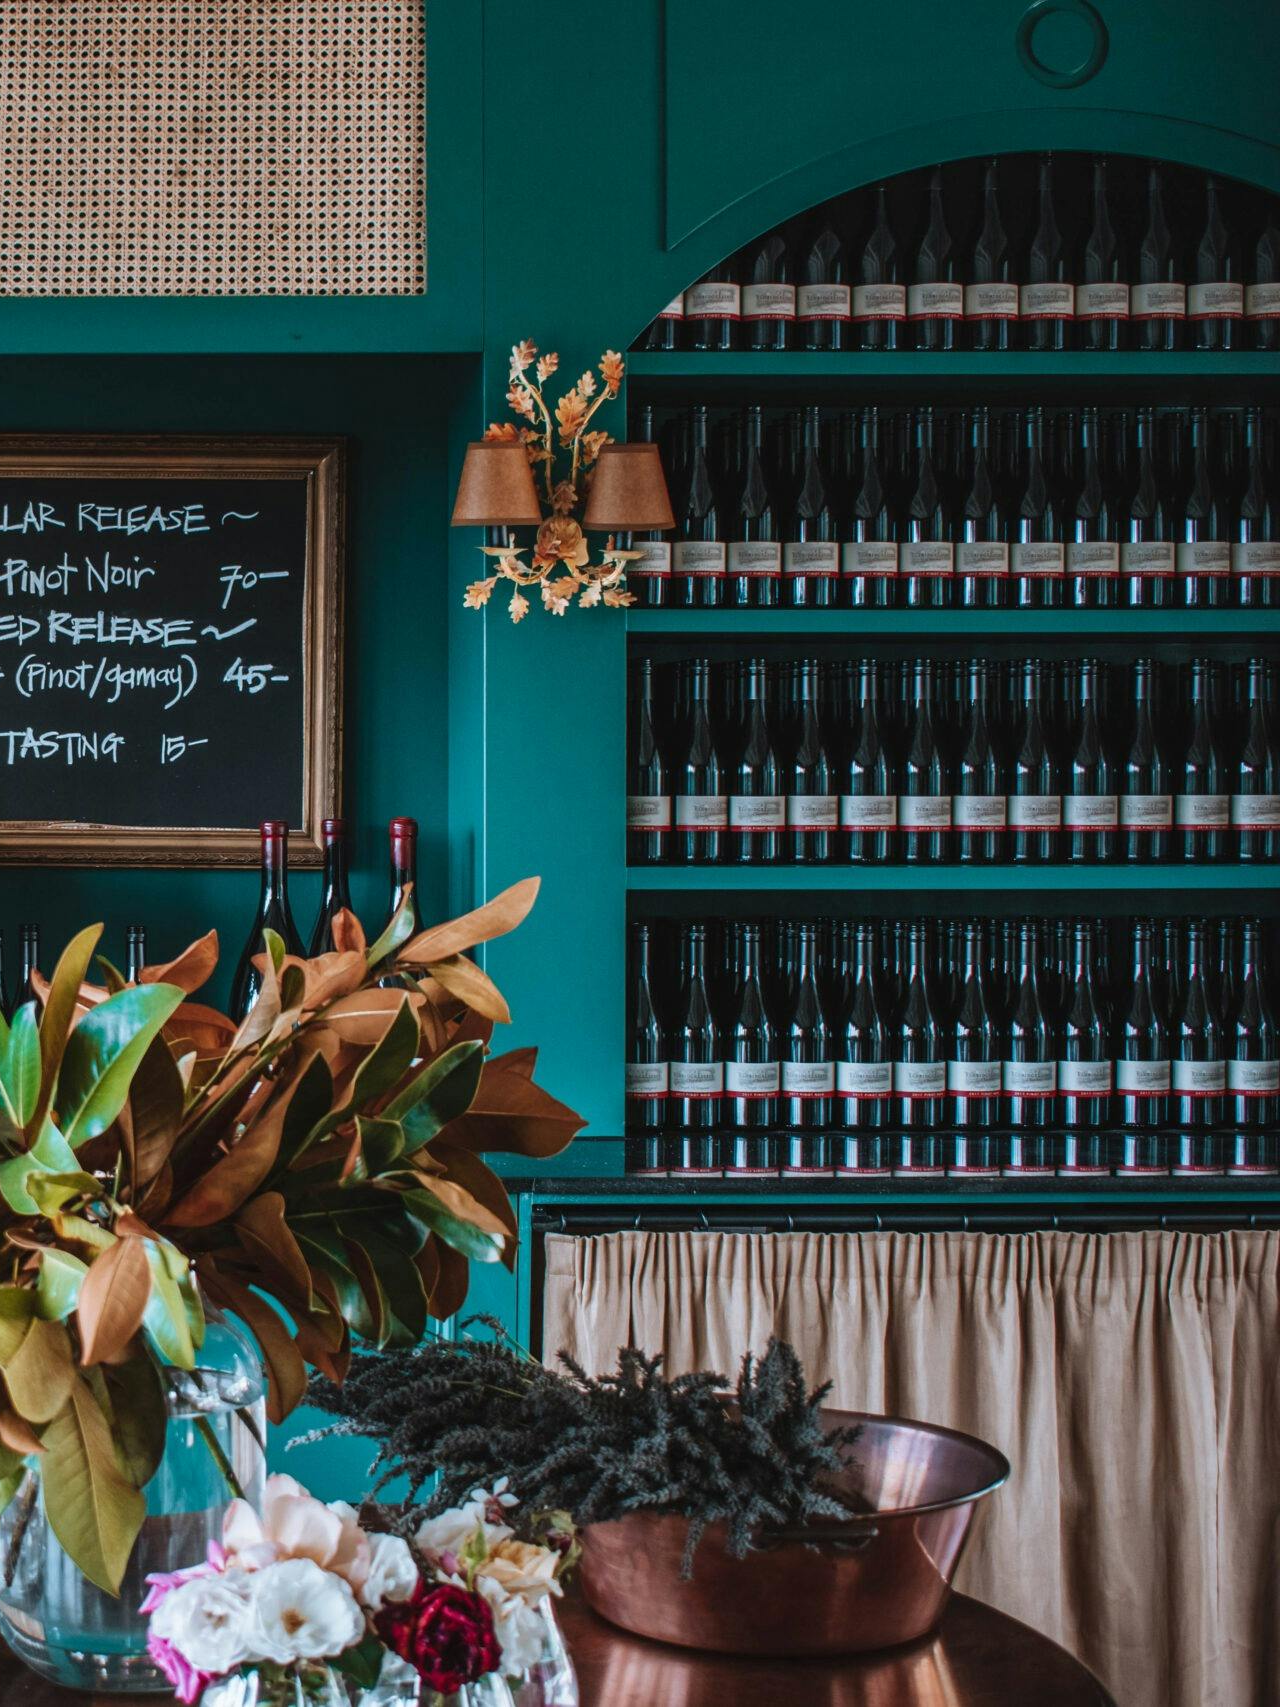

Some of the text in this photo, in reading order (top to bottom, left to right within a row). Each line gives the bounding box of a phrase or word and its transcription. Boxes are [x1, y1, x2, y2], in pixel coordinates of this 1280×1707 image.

[78, 503, 211, 536] RELEASE
[85, 551, 156, 594] Noir
[46, 609, 198, 648] RELEASE
